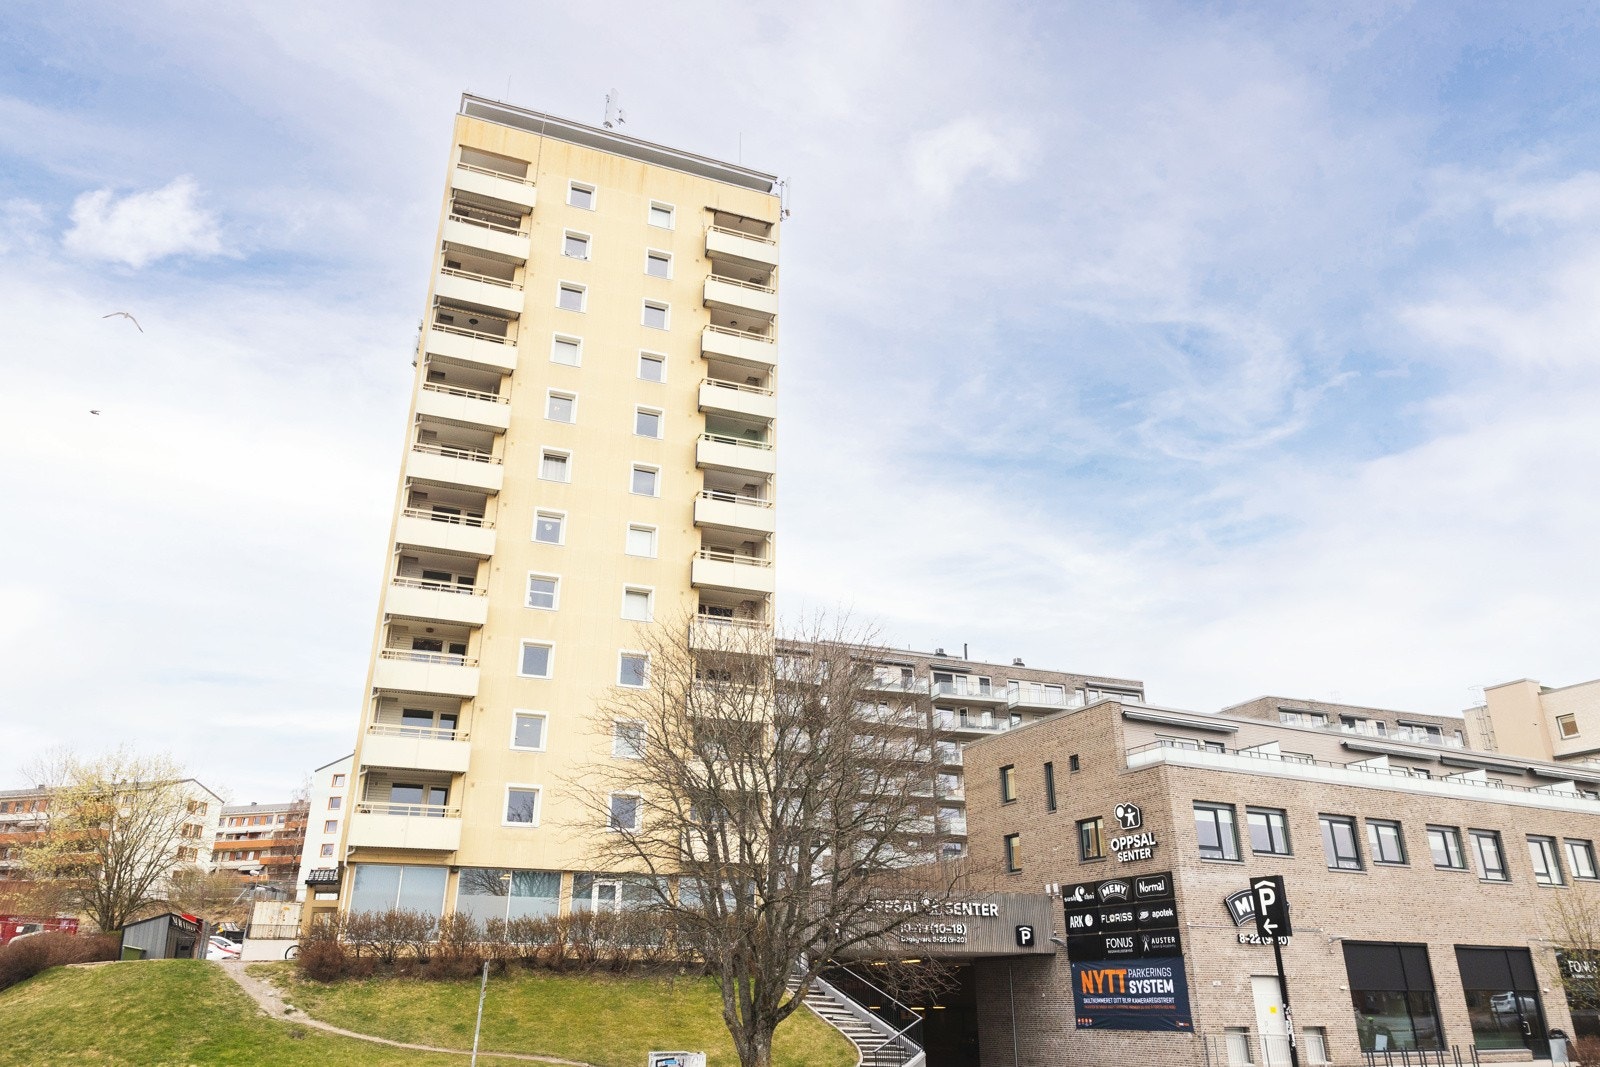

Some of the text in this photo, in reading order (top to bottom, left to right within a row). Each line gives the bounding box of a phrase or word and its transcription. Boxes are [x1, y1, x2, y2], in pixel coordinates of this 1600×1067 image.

[1110, 832, 1156, 851] OPPSAL
[1117, 848, 1152, 862] SENTER
[1101, 884, 1127, 897] MENY
[1139, 880, 1165, 893] Normal
[945, 902, 999, 917] SENTER
[1151, 908, 1174, 918] apotek
[1069, 915, 1084, 929] ARK
[1101, 912, 1133, 924] FLORISS
[1105, 937, 1134, 949] FONUS
[1151, 936, 1176, 945] AUSTER
[1128, 967, 1172, 979] PARKERINGS
[1081, 968, 1127, 994] NYTT
[1129, 979, 1175, 994] SYSTEM
